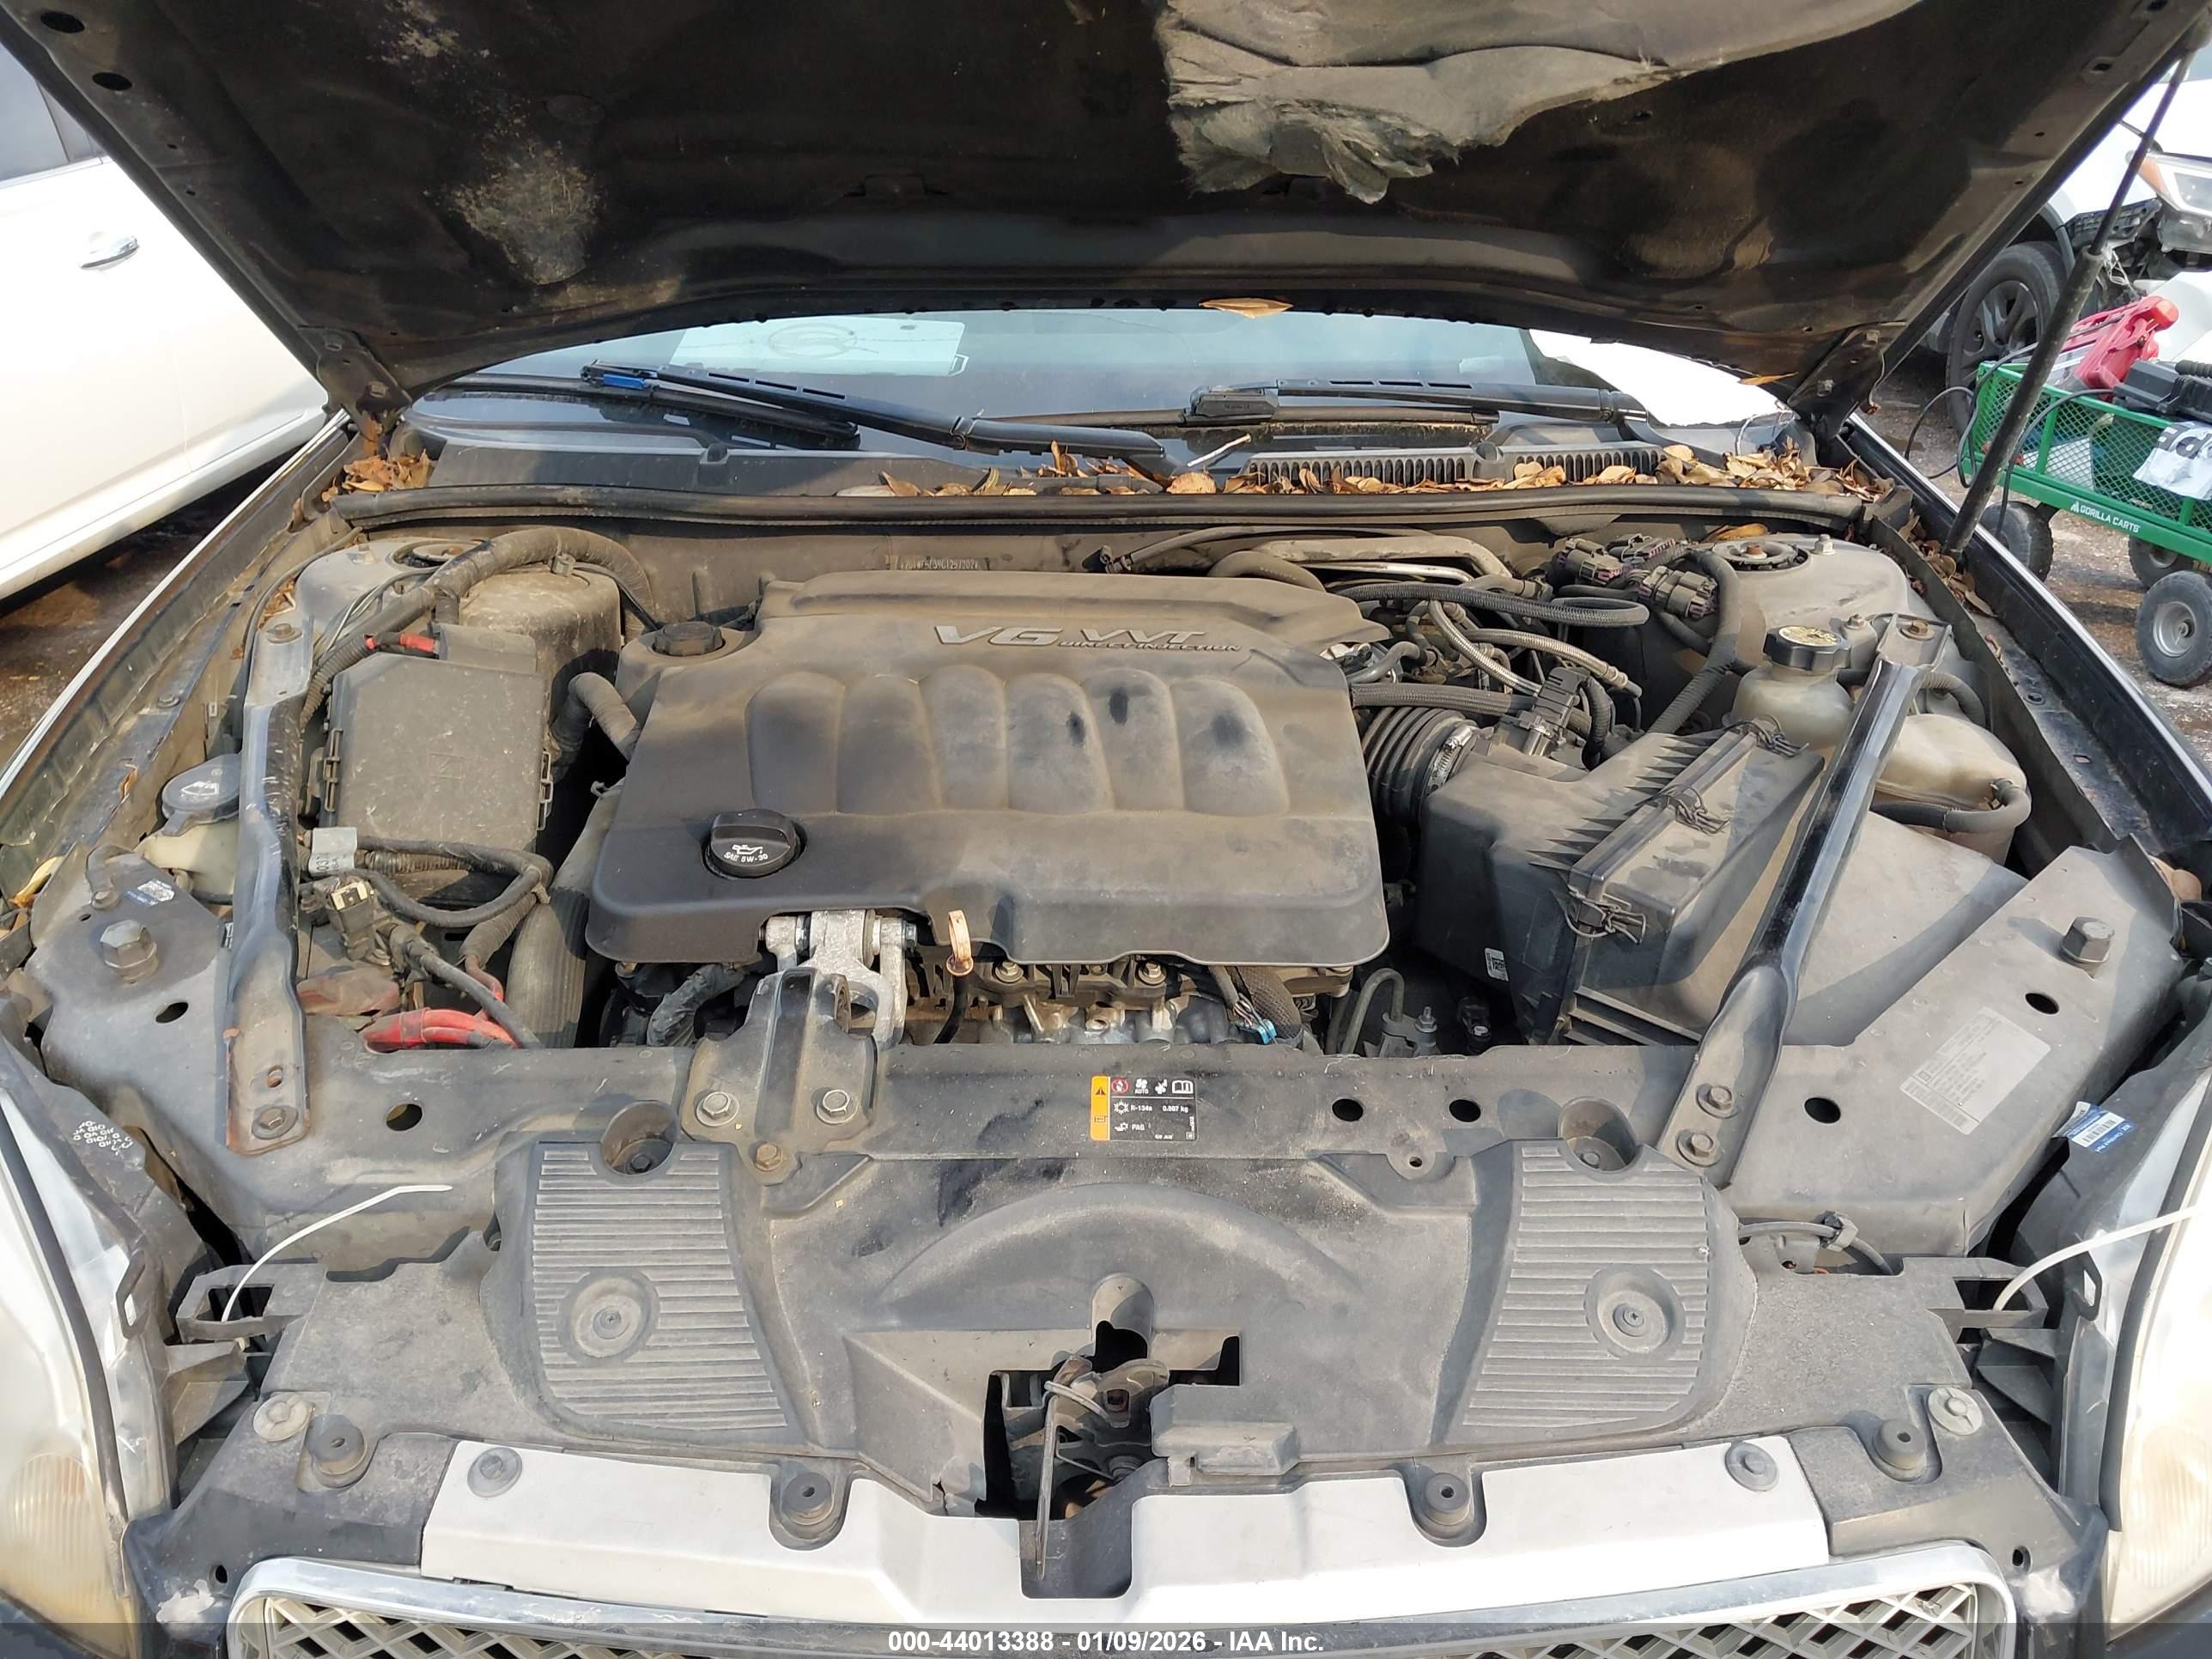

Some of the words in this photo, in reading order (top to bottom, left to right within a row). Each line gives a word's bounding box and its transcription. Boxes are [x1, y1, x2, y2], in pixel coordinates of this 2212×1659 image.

[2080, 505, 2112, 524] GORILLA
[2112, 516, 2140, 533] CARTS
[935, 625, 1063, 647] V6
[1080, 628, 1206, 645] VVT
[1180, 1105, 1189, 1114] kg
[1131, 1123, 1146, 1132] PAG
